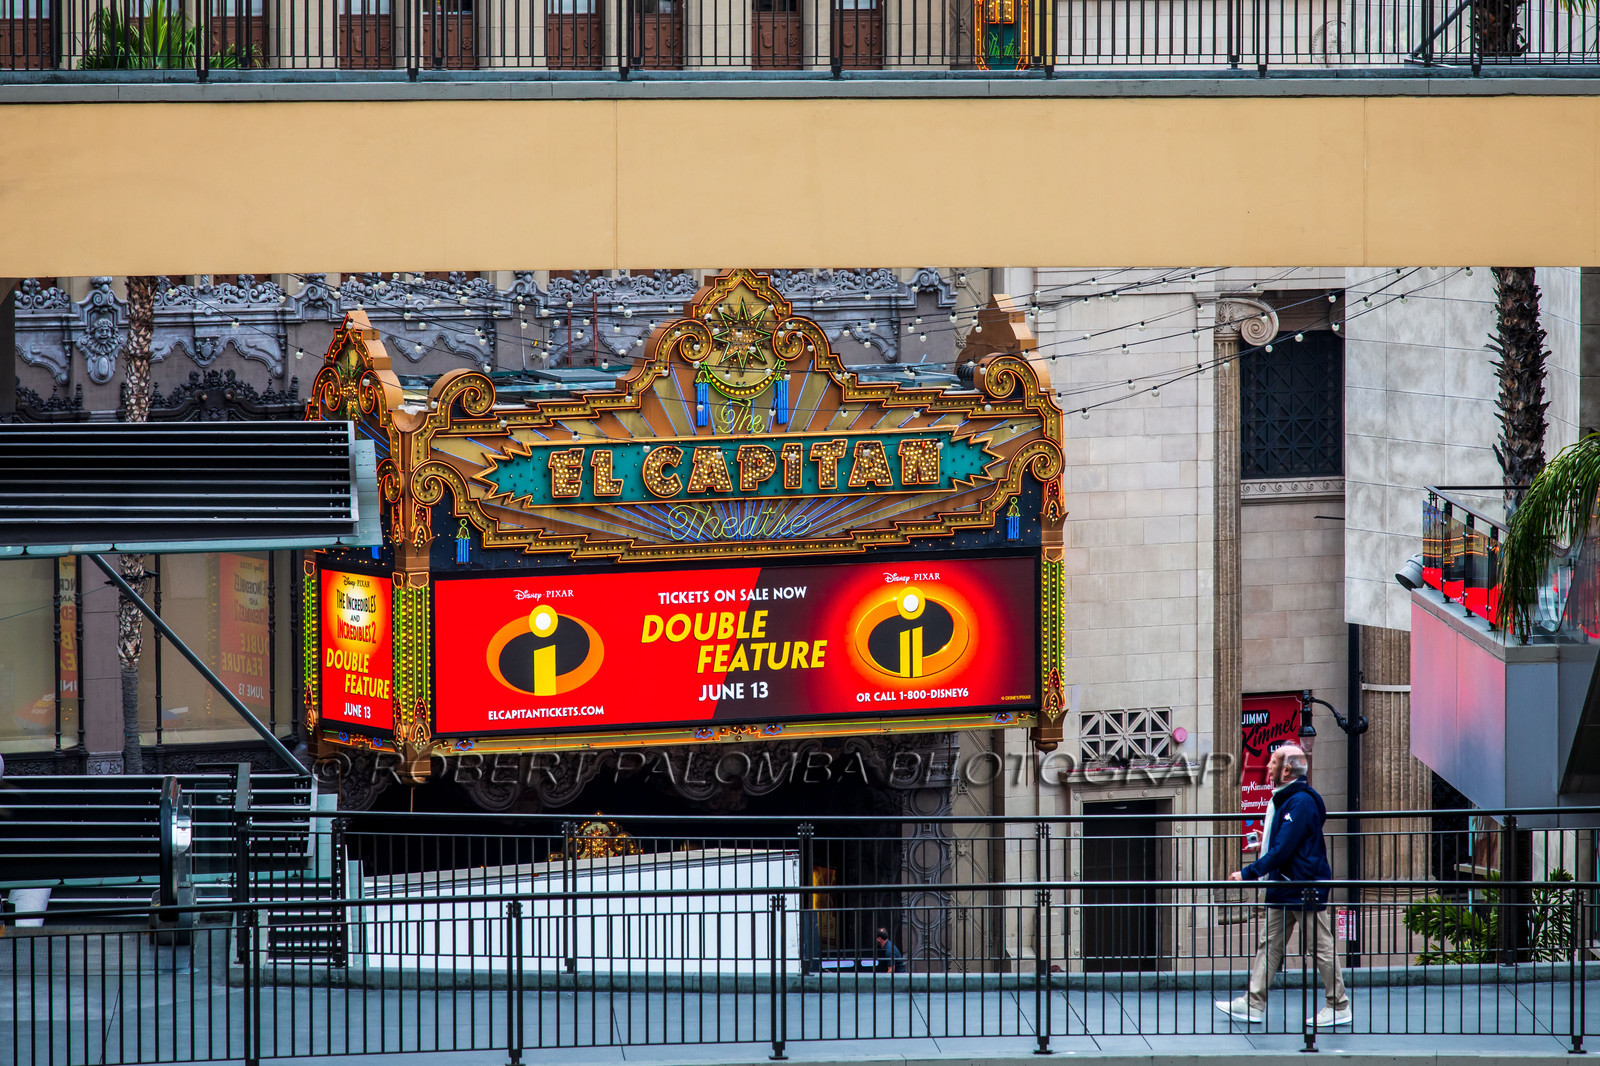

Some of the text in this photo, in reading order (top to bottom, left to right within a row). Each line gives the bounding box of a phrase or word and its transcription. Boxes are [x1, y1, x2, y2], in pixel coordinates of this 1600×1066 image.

[716, 399, 765, 434] The
[548, 438, 941, 498] EL CAPITAN
[667, 504, 812, 541] Theatre
[914, 572, 941, 581] PIXAR
[336, 588, 377, 614] THE INCREDIBLES
[545, 589, 575, 598] PIXAR
[658, 586, 808, 605] TICKETS ON SALE NOW
[336, 614, 377, 644] INCREDIBLES 2
[350, 614, 361, 623] AND
[640, 609, 769, 644] DOUBLE
[326, 647, 370, 675] DOUBLE
[697, 640, 828, 674] FEATURE
[344, 673, 390, 700] FEATURE
[698, 681, 769, 702] JUNE 13
[856, 687, 969, 702] OR CALL 1-800-DISNEY6
[343, 702, 371, 720] JUNE 13
[488, 704, 605, 721] ELCAPITANTICKETS.COM
[1241, 712, 1269, 725] JIMMY
[1241, 708, 1298, 758] Kimmel
